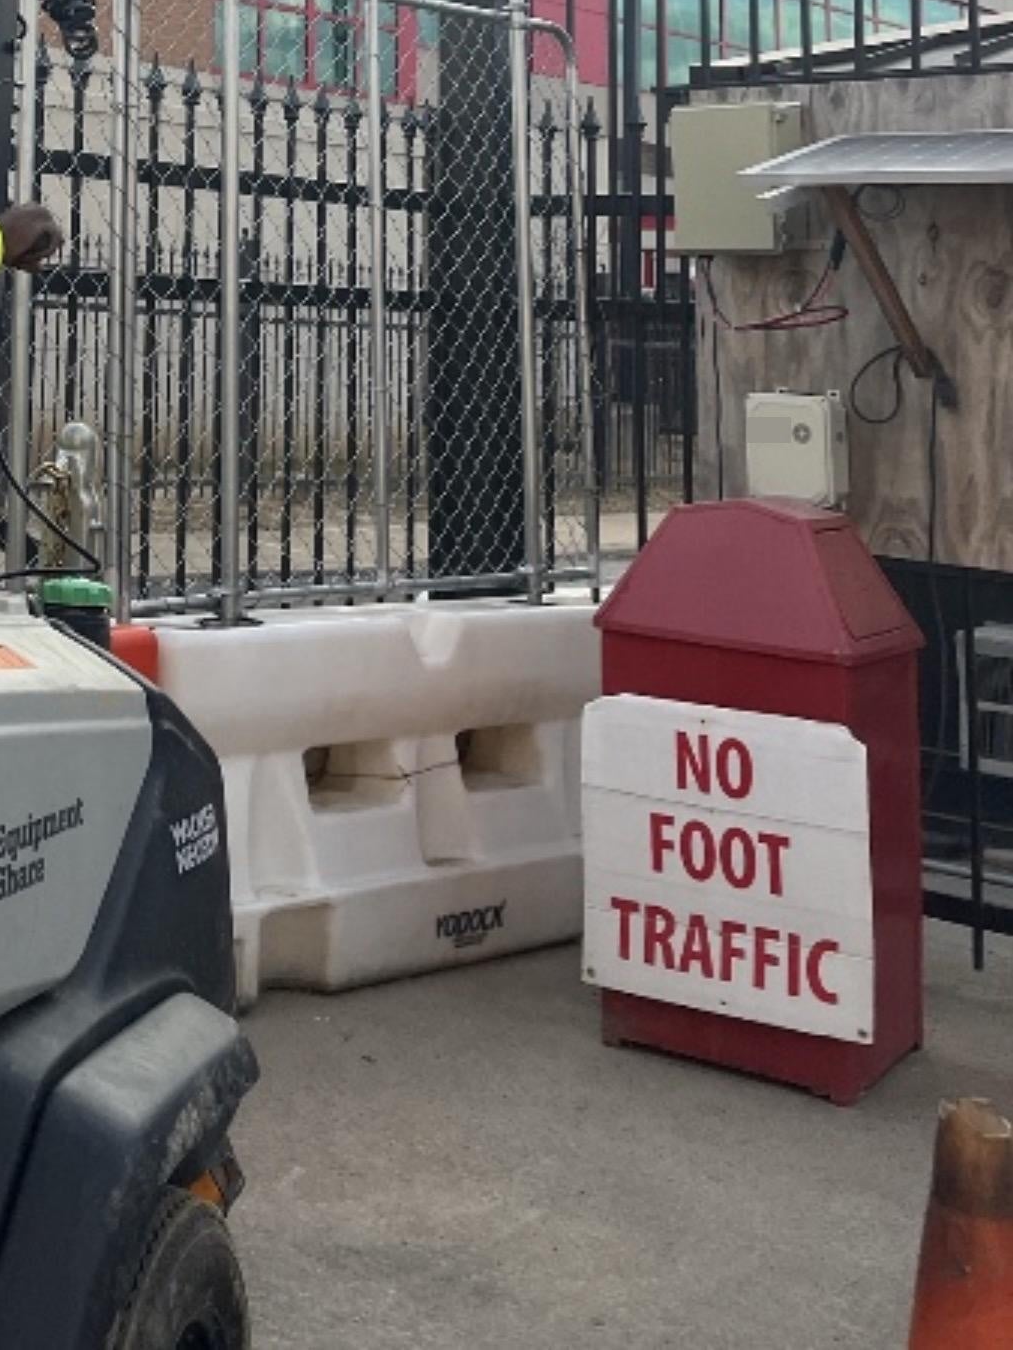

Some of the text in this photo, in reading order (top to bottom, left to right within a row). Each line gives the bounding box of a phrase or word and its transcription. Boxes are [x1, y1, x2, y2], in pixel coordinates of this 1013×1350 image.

[675, 730, 754, 800] NO
[649, 812, 791, 898] FOOT
[610, 896, 840, 1006] TRAFFIC
